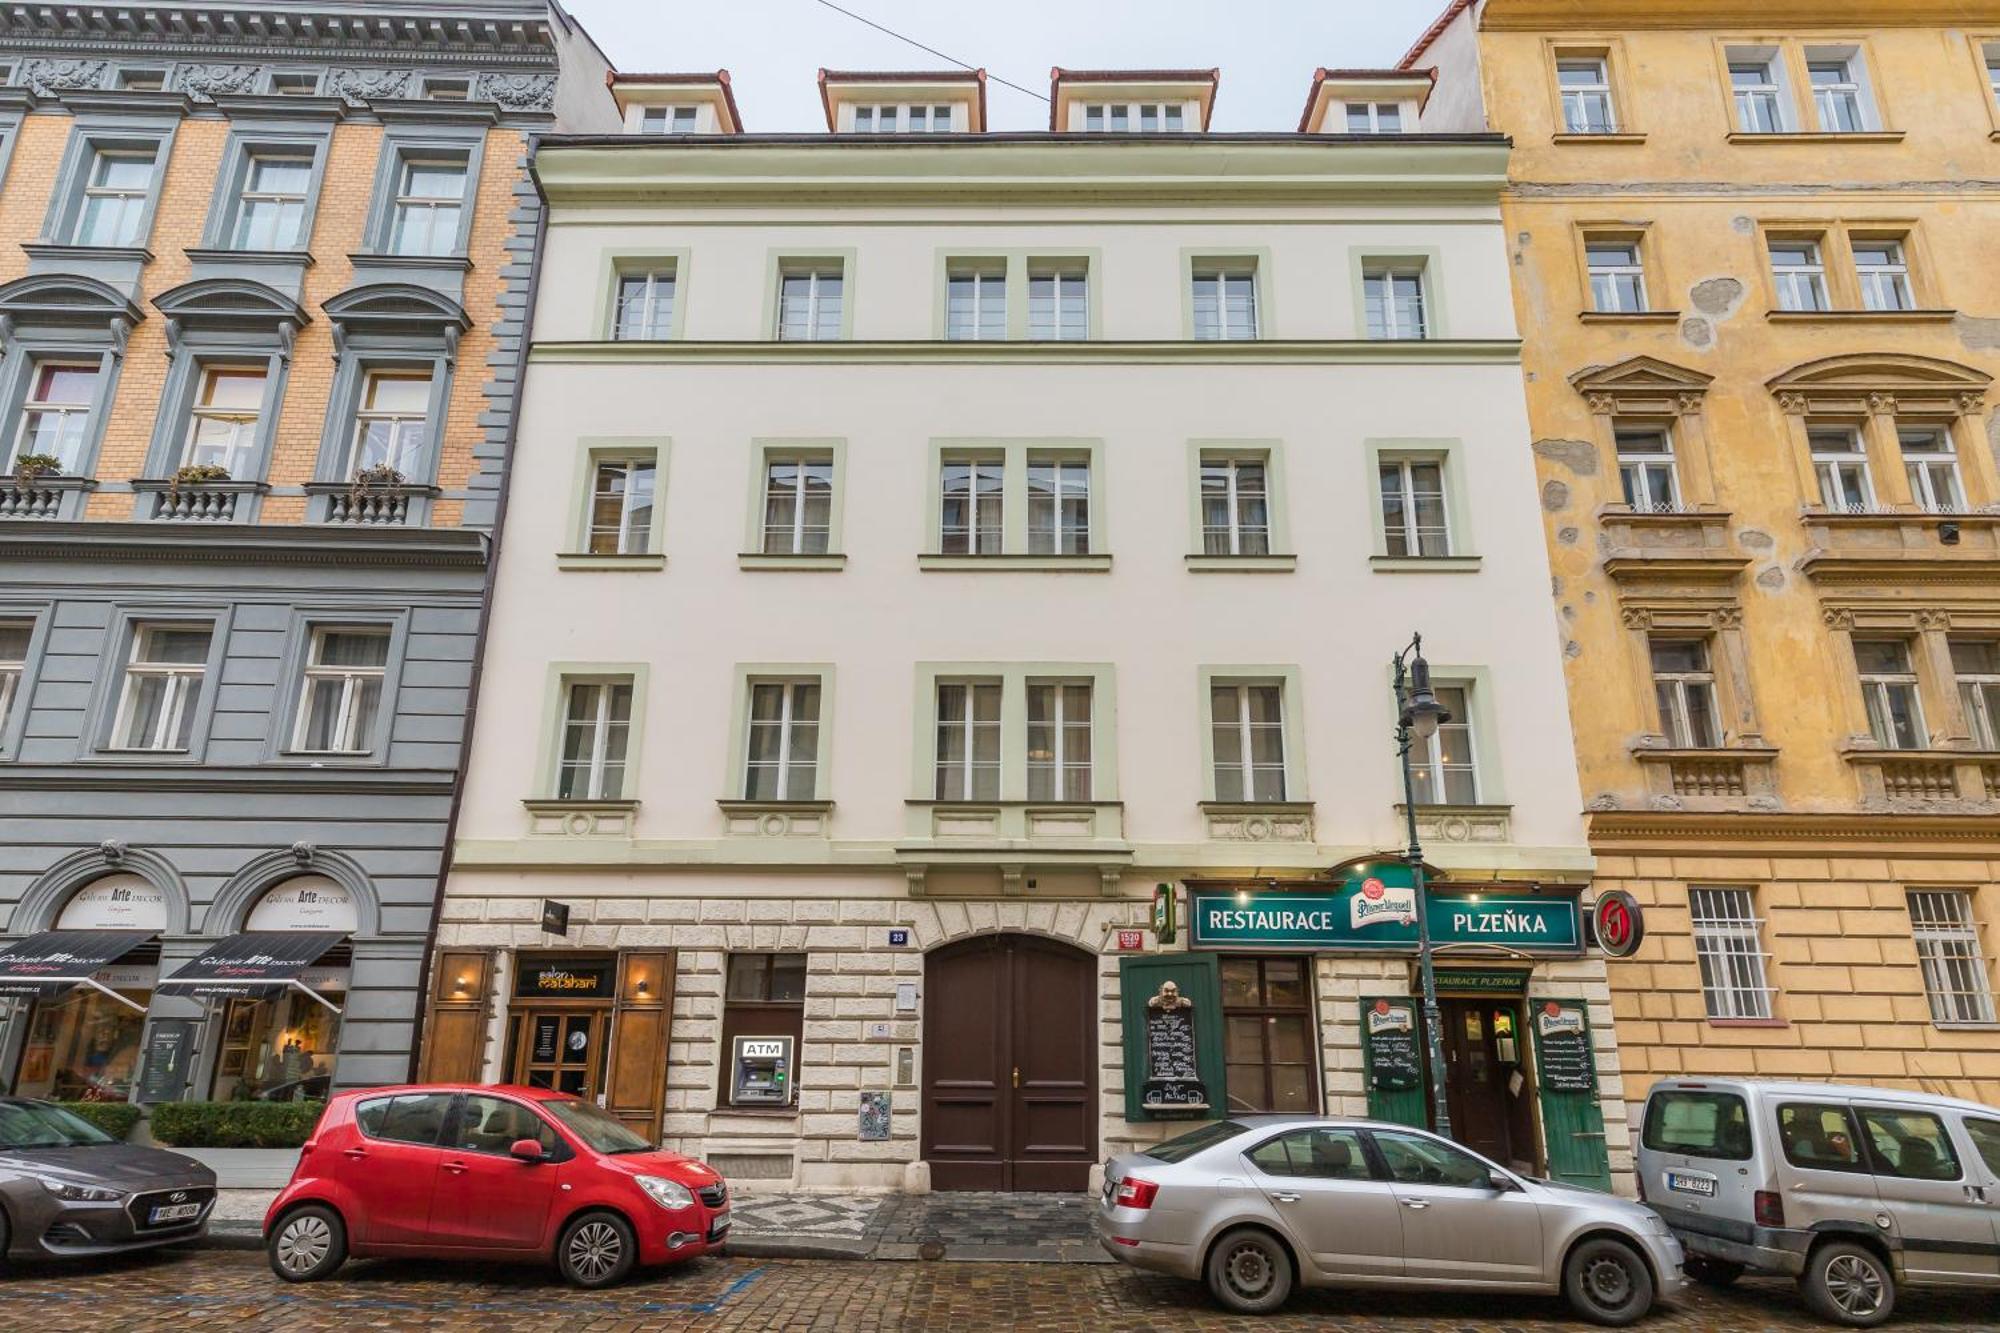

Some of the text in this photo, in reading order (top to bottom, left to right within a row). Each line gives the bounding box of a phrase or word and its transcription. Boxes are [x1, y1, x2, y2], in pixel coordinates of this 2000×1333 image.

[111, 888, 132, 902] Arte
[298, 890, 318, 903] Arte
[1209, 910, 1334, 930] RESTAURACE
[1453, 909, 1548, 933] PLZEŇKA
[892, 933, 904, 942] 23
[539, 964, 569, 979] salon
[746, 1044, 780, 1054] ATM
